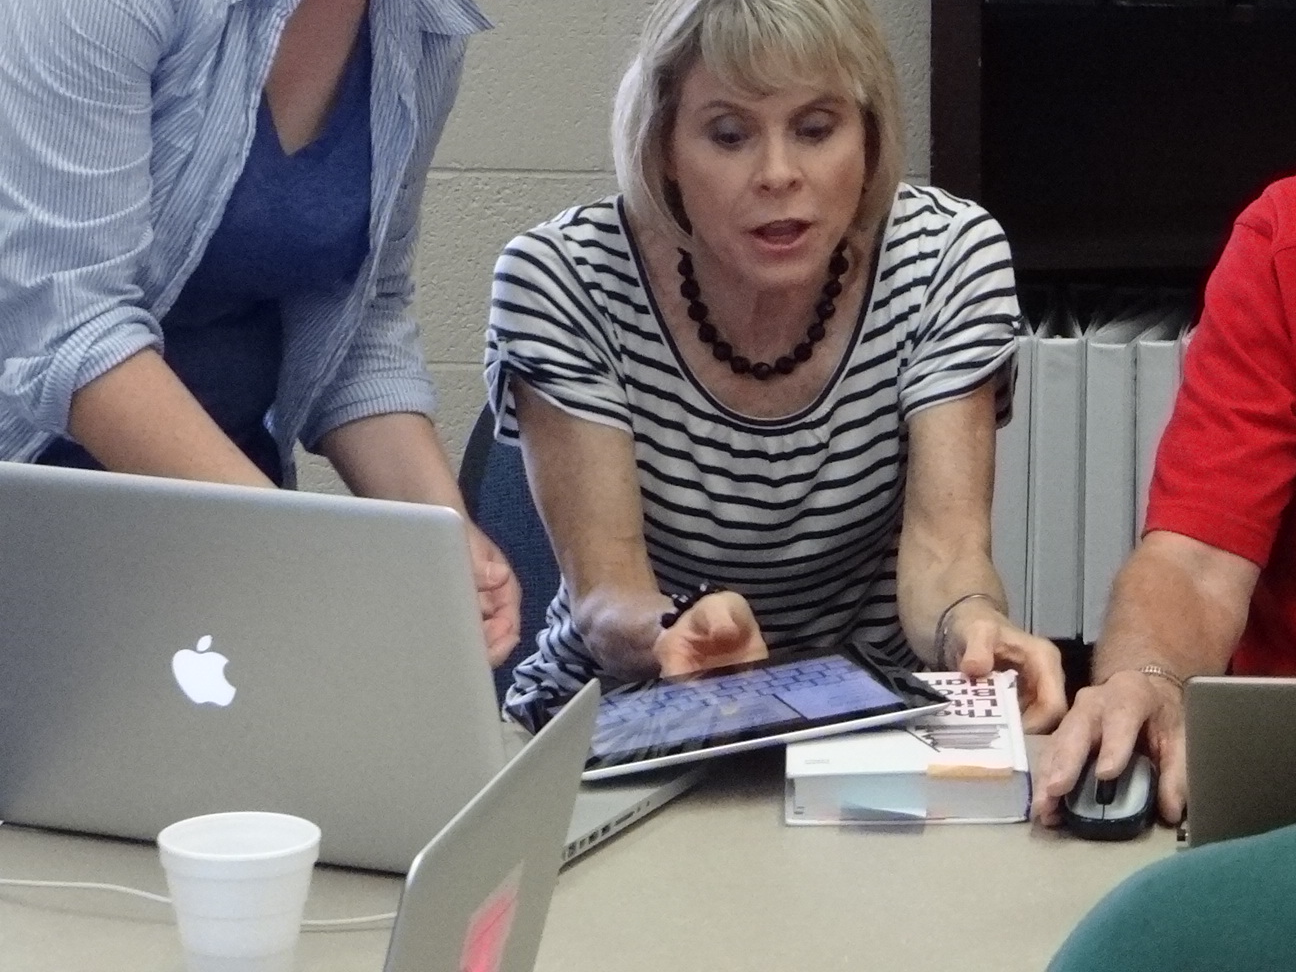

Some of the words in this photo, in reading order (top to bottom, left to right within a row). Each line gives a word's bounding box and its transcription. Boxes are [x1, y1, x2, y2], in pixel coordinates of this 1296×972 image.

[929, 678, 994, 687] Han
[937, 688, 996, 697] Bro
[951, 699, 998, 708] Lit
[934, 709, 1002, 718] The
